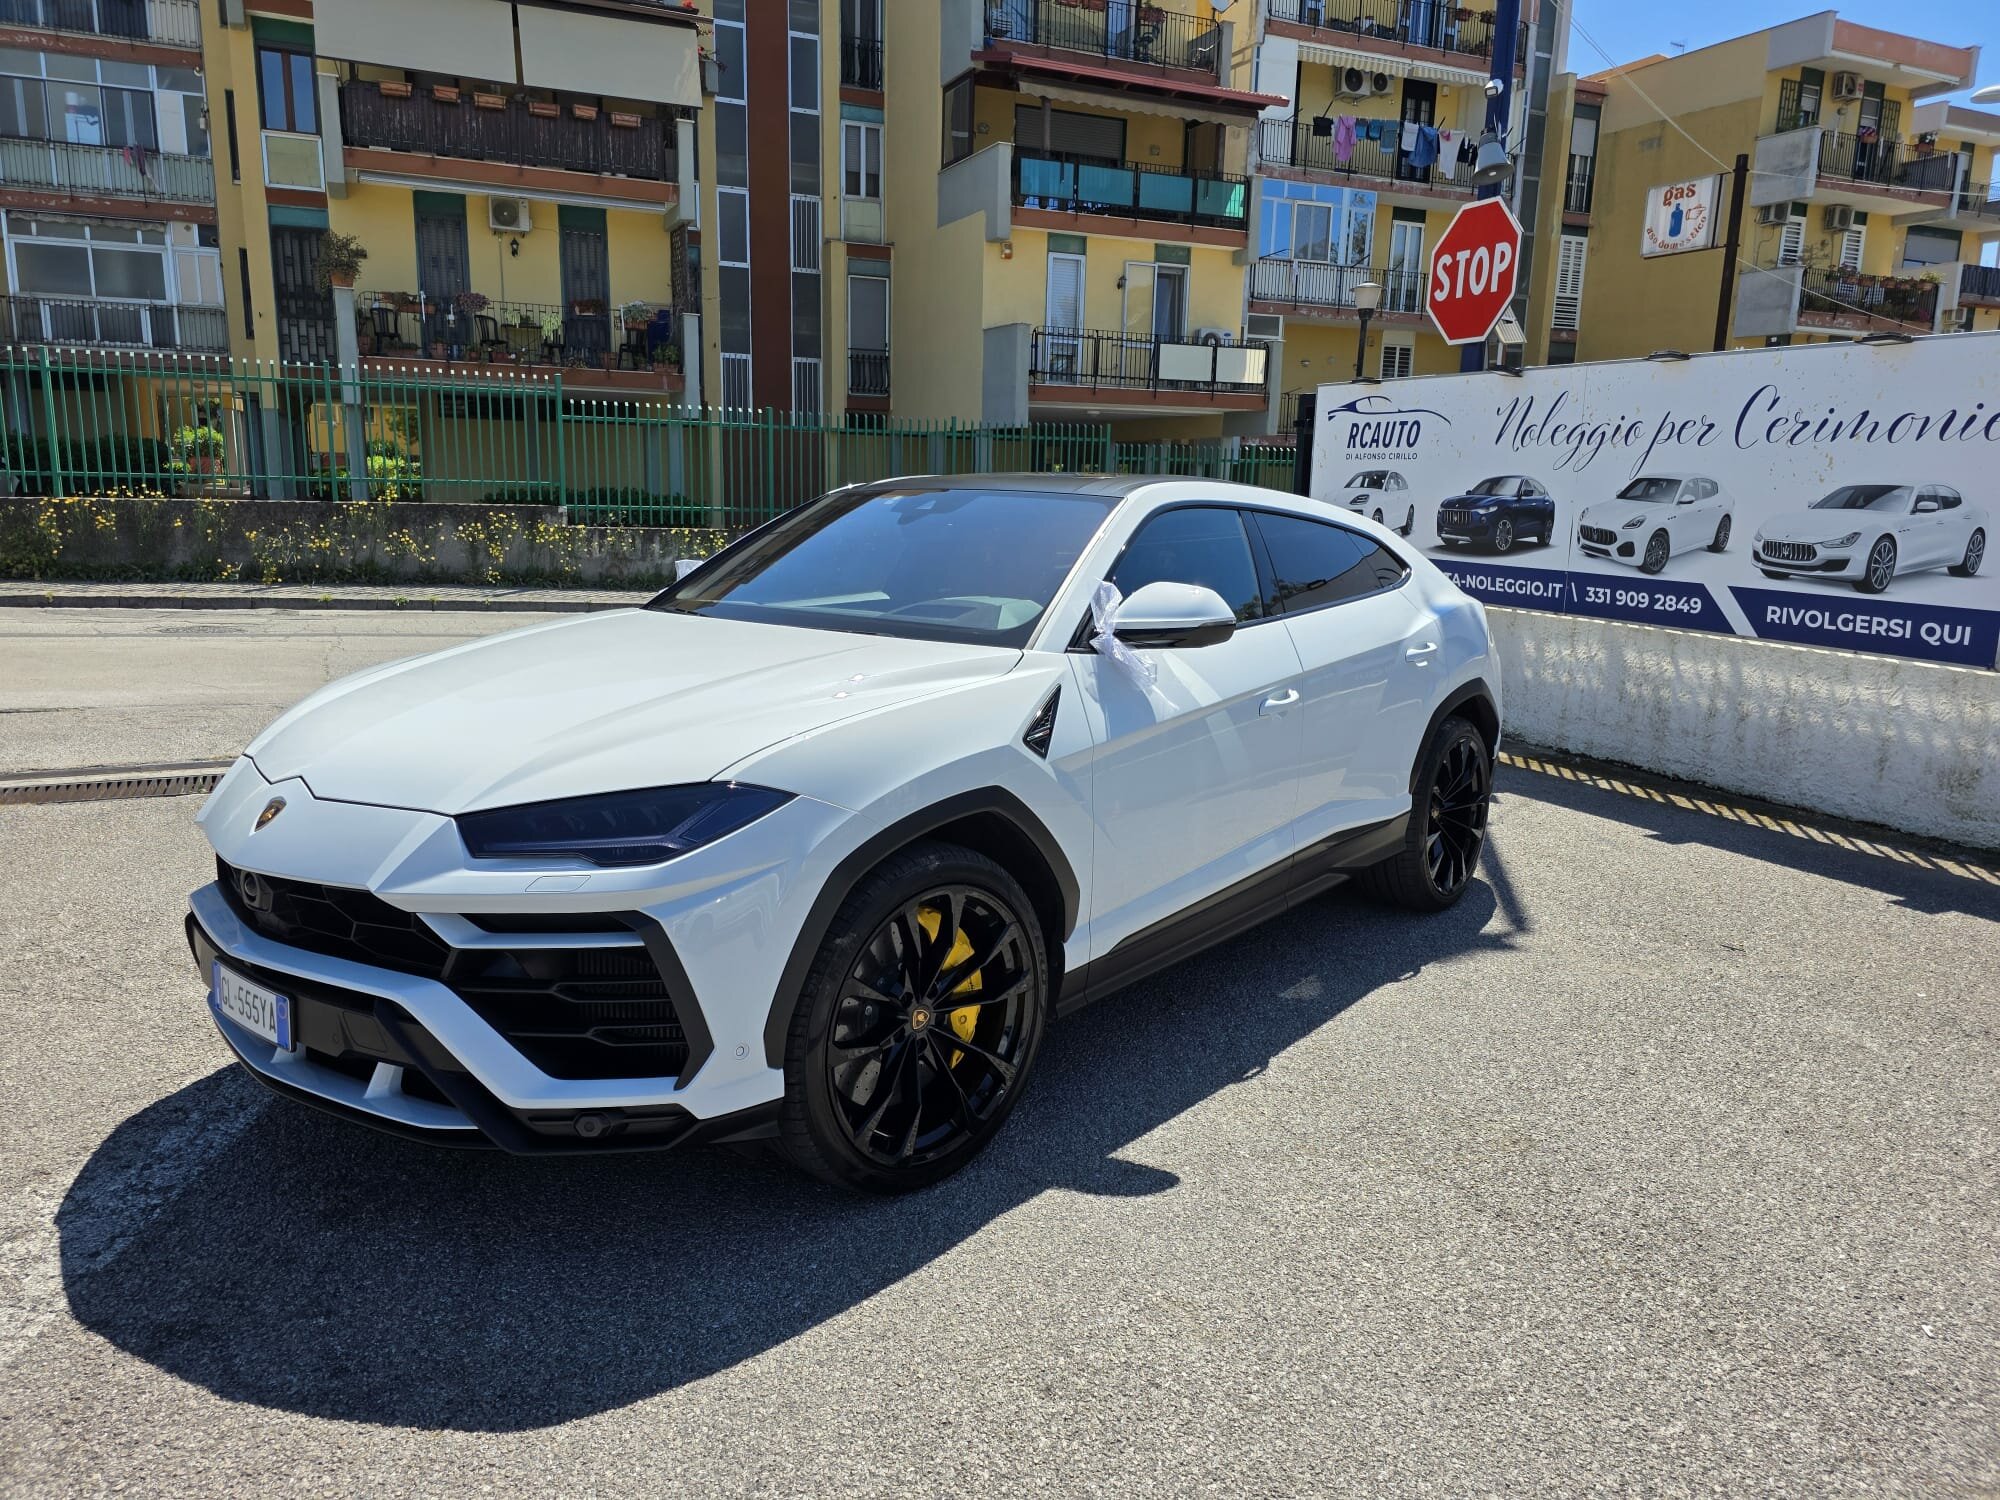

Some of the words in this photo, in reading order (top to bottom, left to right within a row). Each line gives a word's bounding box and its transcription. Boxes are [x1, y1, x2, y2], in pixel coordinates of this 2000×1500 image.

[1663, 183, 1697, 207] gas
[1433, 241, 1512, 302] STOP
[1346, 419, 1421, 449] RCAUTO
[1495, 390, 1646, 473] Noleggio
[1629, 410, 1723, 480] per
[1734, 384, 2000, 450] Cerimonie
[1388, 452, 1418, 460] CIRILLO
[1585, 586, 1611, 604] 331
[1615, 590, 1650, 608] 909
[1653, 594, 1702, 614] 2849
[1766, 605, 1913, 639] RIVOLGERSI
[1919, 622, 1972, 646] QUI
